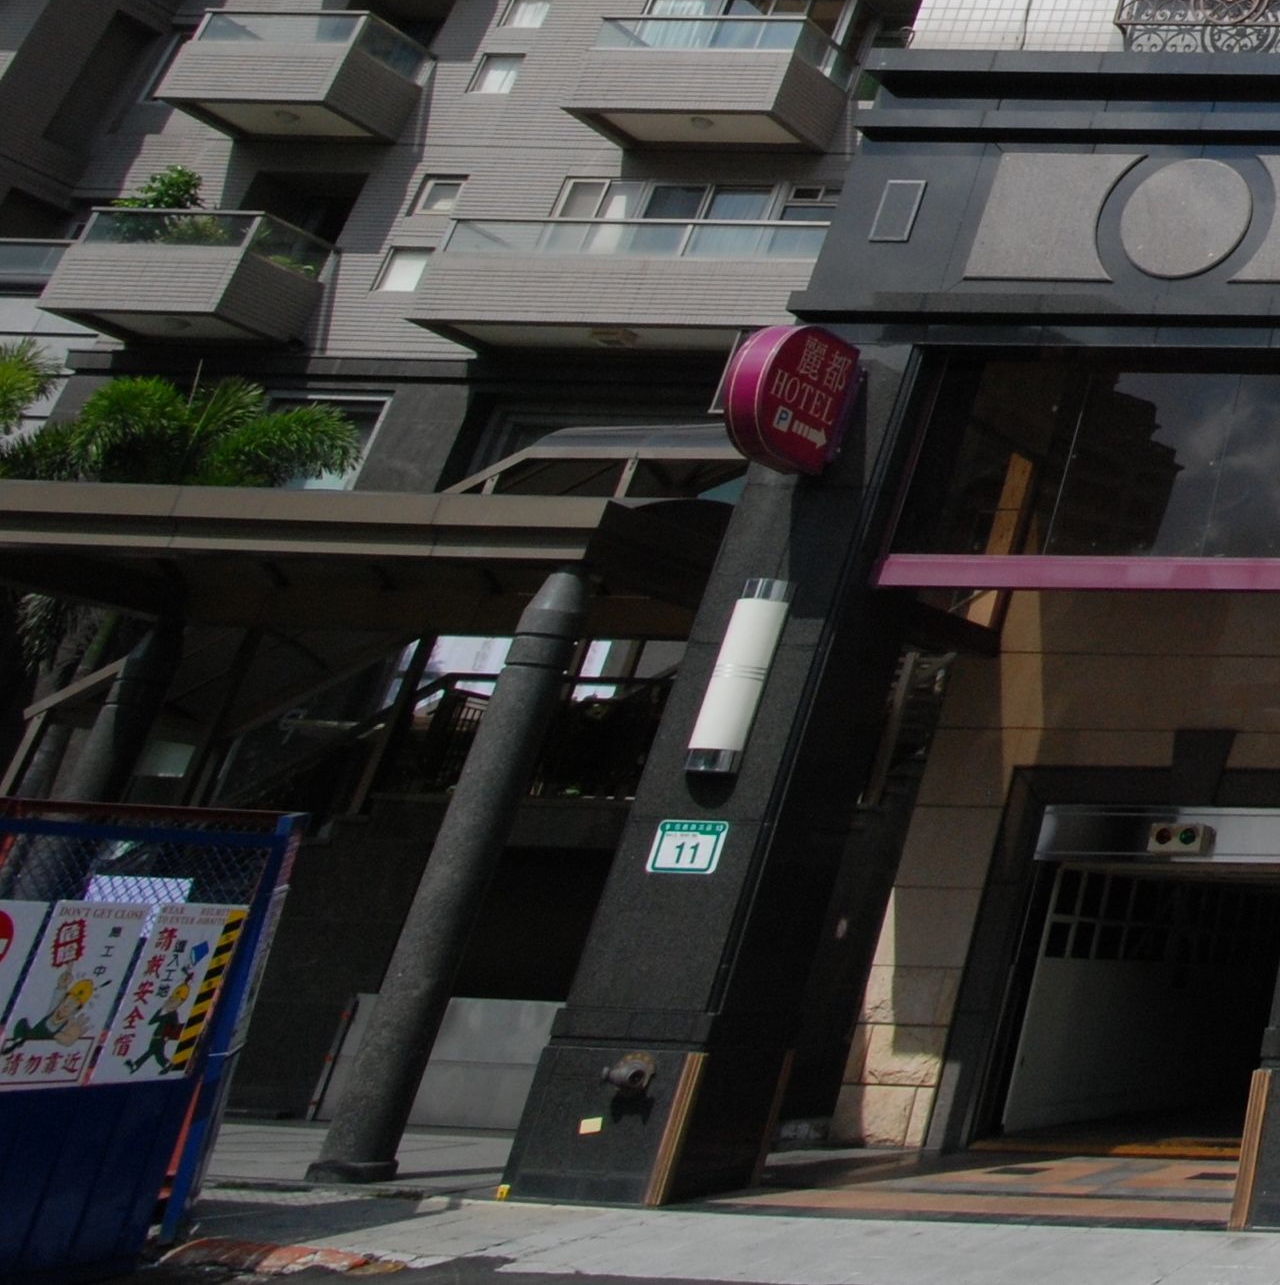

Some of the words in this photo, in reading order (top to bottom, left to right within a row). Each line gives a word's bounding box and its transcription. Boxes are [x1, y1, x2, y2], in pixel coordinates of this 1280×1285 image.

[797, 335, 852, 393] 麗都
[770, 369, 835, 426] HOTEL
[675, 841, 700, 865] 11
[60, 906, 92, 918] DON'T
[93, 907, 114, 918] GET
